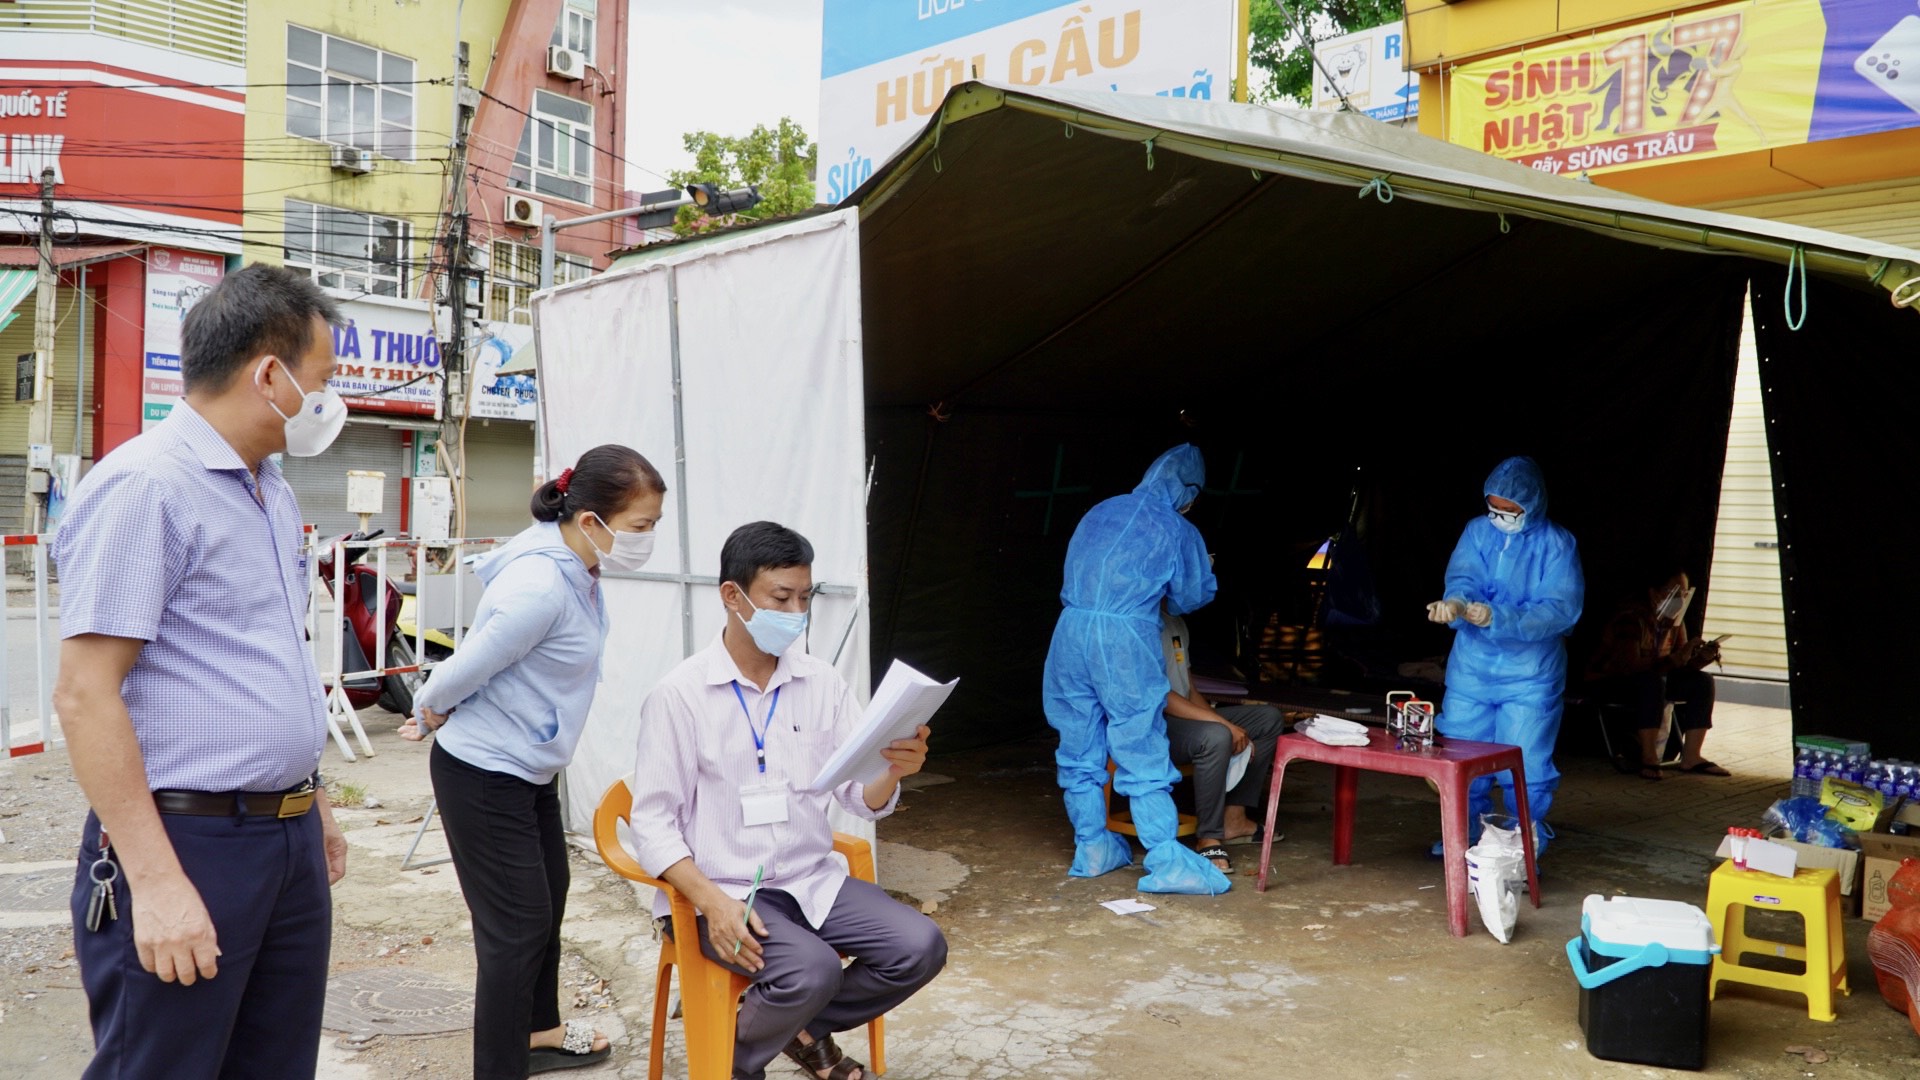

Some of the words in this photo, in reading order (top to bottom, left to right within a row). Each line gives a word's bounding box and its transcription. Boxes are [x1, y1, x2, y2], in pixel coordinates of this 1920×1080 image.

[1008, 6, 1141, 87] CẦU
[1385, 34, 1401, 60] R
[1602, 13, 1743, 136] 17
[0, 89, 42, 118] QUỐC
[45, 90, 69, 118] TẾ
[1567, 145, 1629, 171] SỪNG
[1633, 131, 1695, 160] TRÂU
[827, 146, 872, 205] SỬA
[371, 329, 440, 367] THUỐ
[335, 364, 365, 378] IM
[1200, 849, 1229, 857] adida
